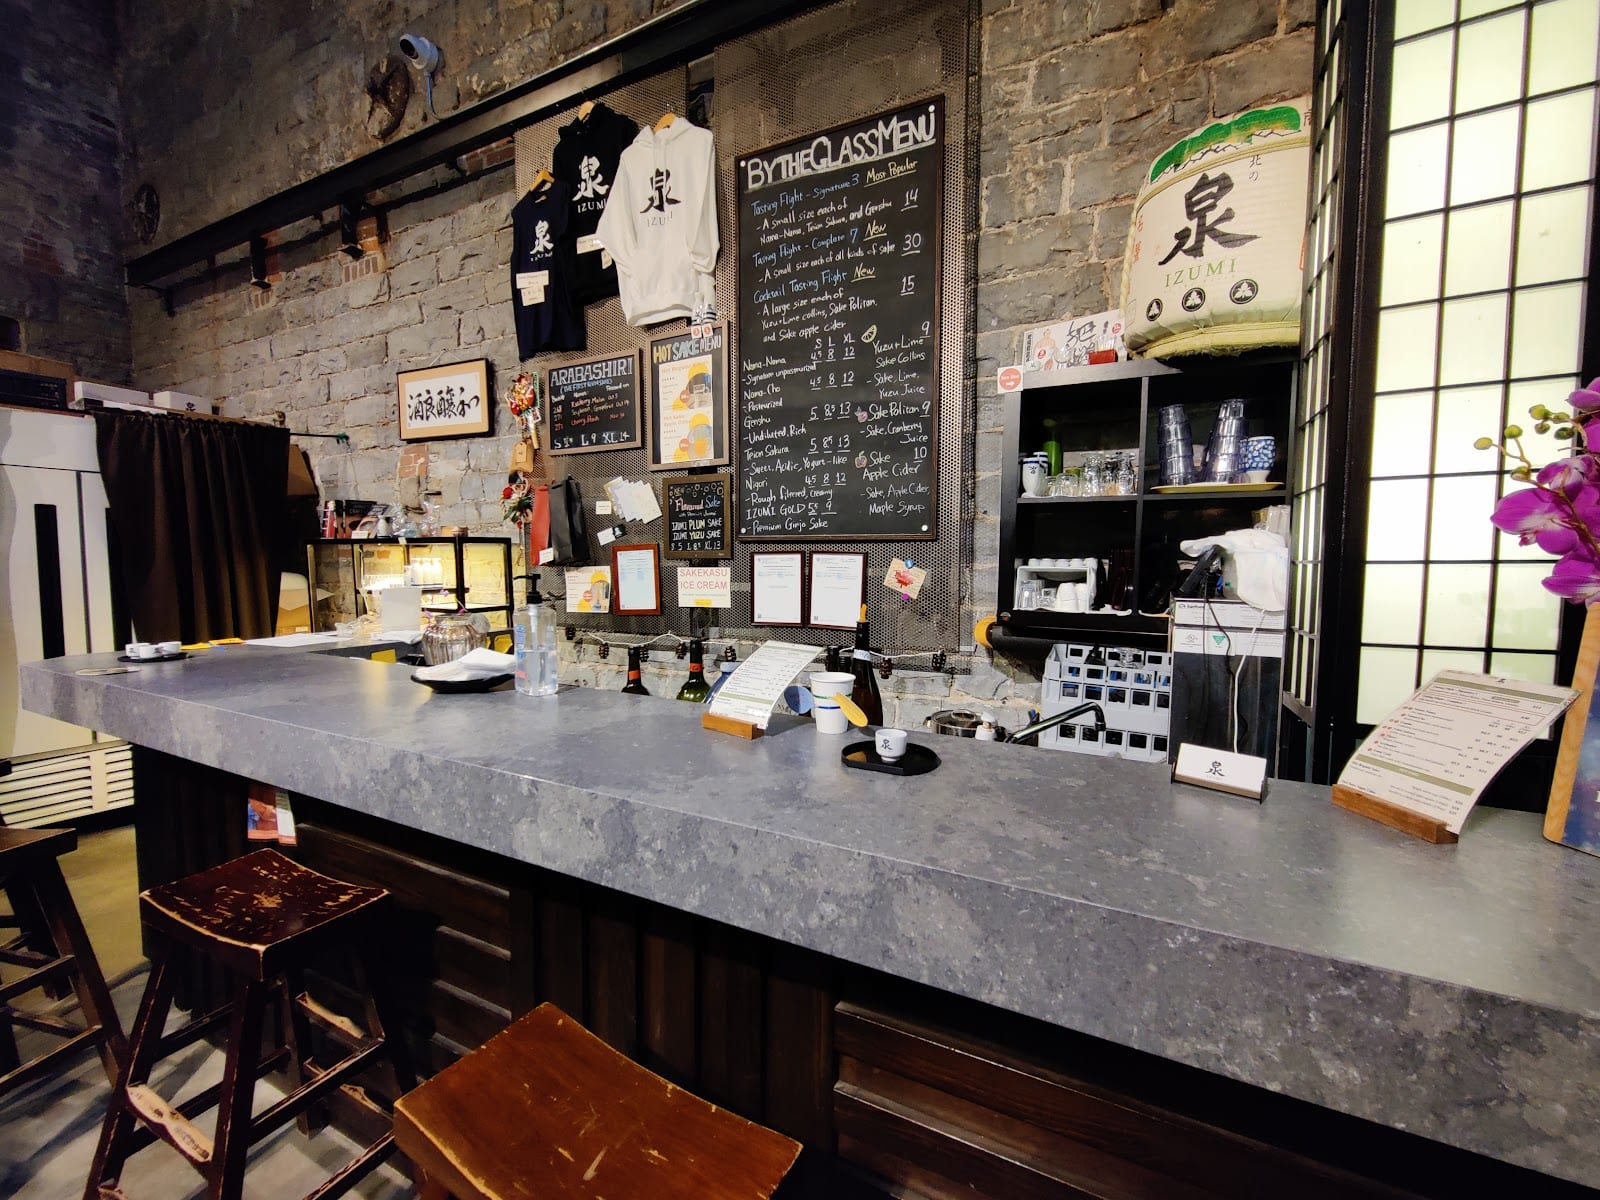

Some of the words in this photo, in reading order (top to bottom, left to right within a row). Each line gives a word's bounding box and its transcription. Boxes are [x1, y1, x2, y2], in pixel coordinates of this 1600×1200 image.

[572, 155, 610, 202] 泉
[779, 188, 803, 209] Flight
[852, 173, 860, 186] 3
[888, 157, 918, 177] Popular
[639, 168, 682, 214] 泉
[771, 210, 796, 230] small
[817, 201, 836, 216] each
[837, 196, 848, 210] of
[904, 187, 919, 207] 14
[1158, 172, 1262, 266] 泉
[530, 219, 554, 255] 泉
[850, 228, 858, 244] 7
[865, 220, 887, 238] New
[903, 233, 922, 251] 30
[1165, 257, 1237, 288] IZUMI
[753, 284, 785, 304] Cocktail
[789, 279, 818, 292] Tasting
[821, 268, 847, 287] Flight
[854, 262, 876, 279] New
[900, 275, 916, 293] 15
[833, 288, 844, 299] of
[824, 320, 847, 332] cider
[921, 320, 930, 336] 9
[828, 336, 836, 347] L
[843, 333, 856, 344] XL
[828, 348, 835, 360] 8
[844, 346, 856, 357] 12
[898, 351, 926, 364] Collins
[550, 358, 633, 387] ARABASHIRI
[828, 372, 836, 385] 8
[843, 370, 855, 384] 12
[879, 388, 899, 400] Yuzu
[810, 406, 819, 420] 5
[839, 401, 851, 415] 13
[922, 400, 931, 415] 9
[581, 434, 589, 446] L
[590, 432, 597, 443] 9
[602, 431, 618, 443] XL
[809, 437, 818, 452] 5
[838, 434, 850, 448] 13
[900, 433, 929, 444] Juice
[914, 446, 928, 460] 10
[862, 467, 889, 481] Apple
[892, 462, 921, 477] Cider
[745, 476, 768, 491] Nigori
[823, 473, 831, 484] 8
[836, 472, 847, 483] 12
[746, 506, 776, 520] IZUMI
[780, 503, 806, 516] GOLD
[826, 501, 832, 511] 9
[869, 501, 894, 516] Maple
[897, 500, 926, 517] Syrup
[689, 519, 706, 530] PLUM
[707, 517, 723, 528] SAKE
[689, 531, 705, 540] YUZU
[706, 529, 721, 539] SAKE
[679, 568, 728, 578] SAKEKASU
[680, 581, 696, 590] ICE
[696, 581, 728, 590] CREAM
[1204, 760, 1226, 777] 泉
